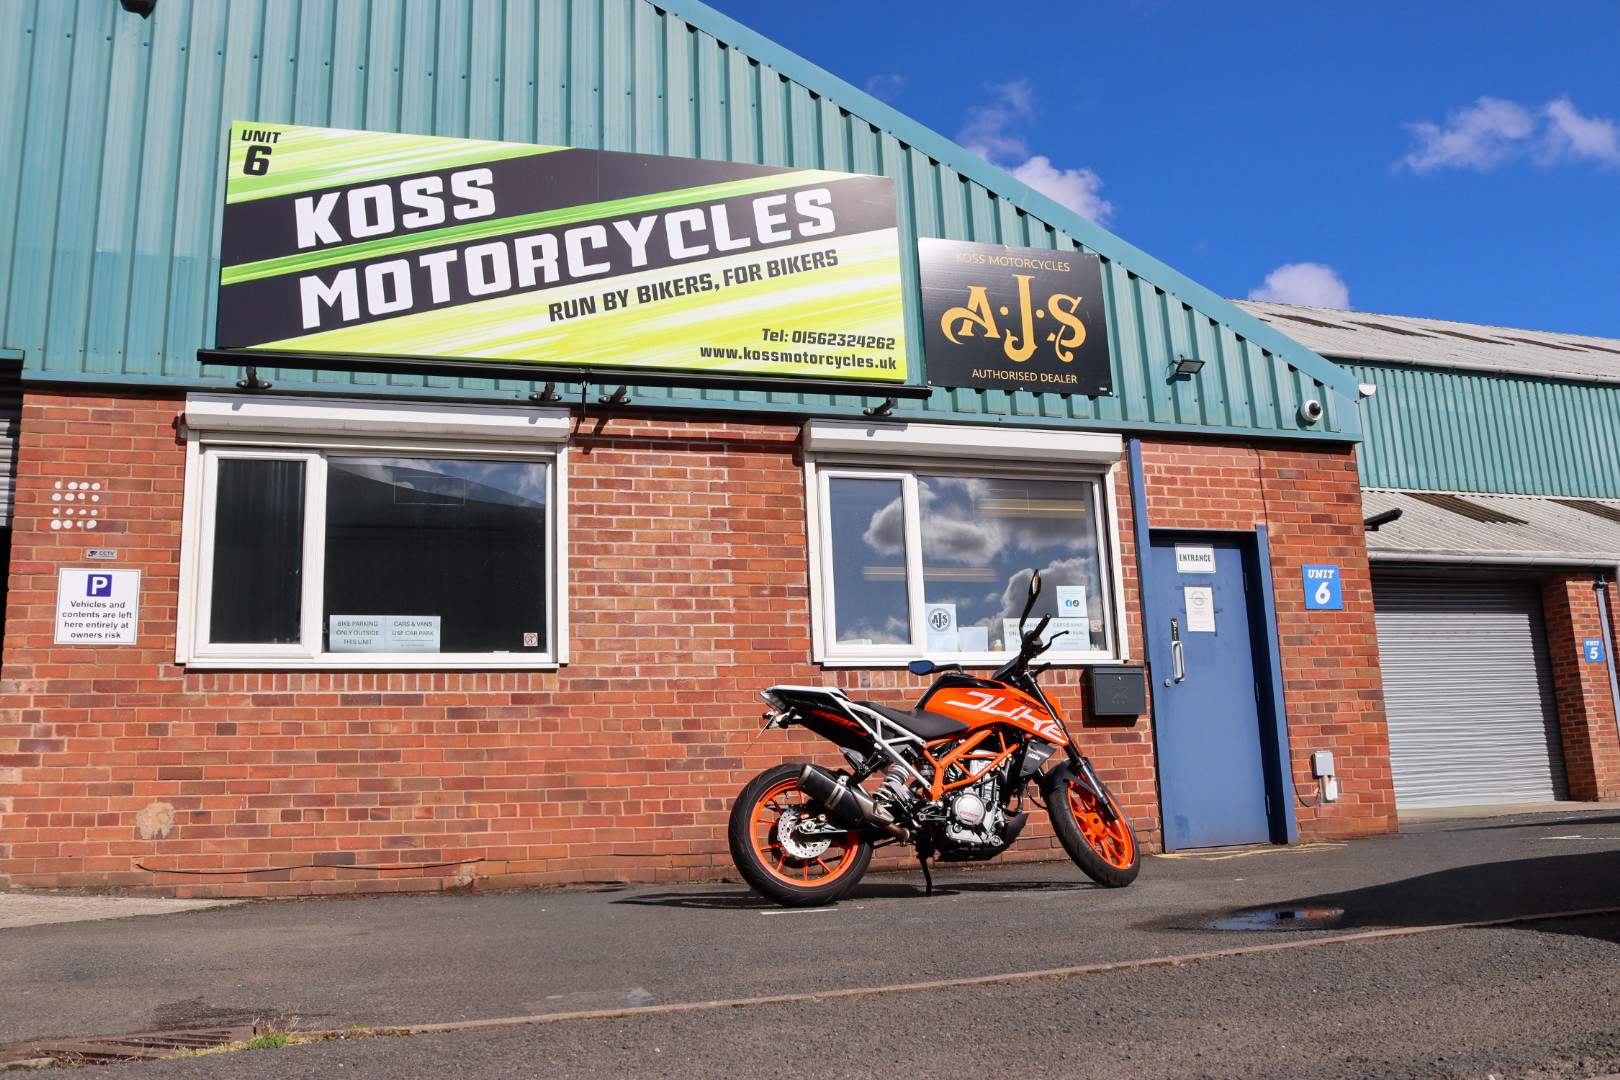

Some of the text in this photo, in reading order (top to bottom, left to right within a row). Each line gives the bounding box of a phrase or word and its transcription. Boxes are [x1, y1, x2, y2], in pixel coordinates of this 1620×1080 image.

[241, 129, 282, 144] UNIT
[243, 145, 273, 176] 6
[294, 167, 496, 249] KOSS
[299, 187, 837, 330] MOTORCYCLES
[956, 252, 1071, 272] KOSS MOTORCYCLES
[548, 248, 839, 322] RUN BY BIKERS, FOR BIKERS
[762, 328, 896, 350] Tel: 01562324262
[700, 346, 897, 370] www.kossmotorcycles.uk
[971, 368, 1078, 384] AUTHORISED DEALER
[1179, 553, 1212, 562] ENTRANCE
[1307, 569, 1335, 579] UNIT
[91, 576, 108, 595] P
[1315, 581, 1331, 605] 6
[70, 600, 126, 609] Vehicles and
[61, 611, 100, 619] contents
[118, 611, 132, 619] left
[64, 621, 84, 629] here
[85, 621, 118, 630] entirely
[104, 631, 121, 639] risk
[1590, 646, 1599, 660] 5
[943, 690, 1068, 744] DUKE
